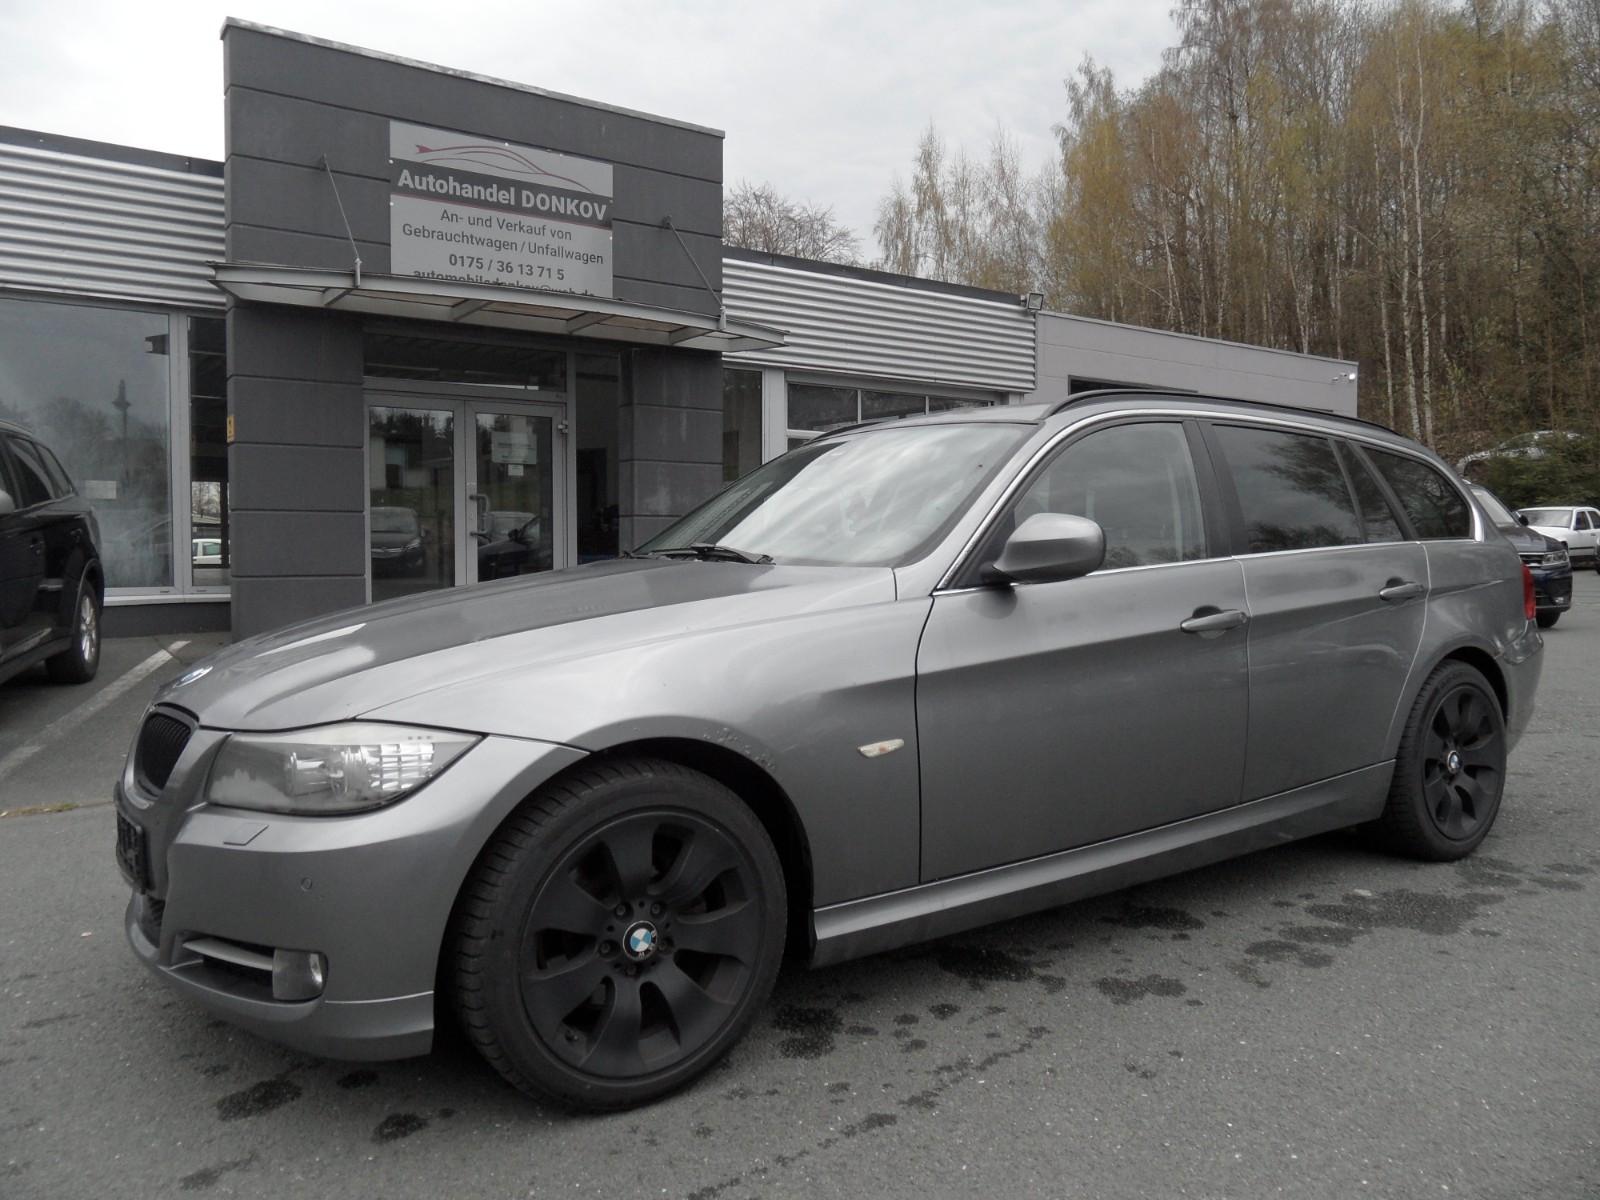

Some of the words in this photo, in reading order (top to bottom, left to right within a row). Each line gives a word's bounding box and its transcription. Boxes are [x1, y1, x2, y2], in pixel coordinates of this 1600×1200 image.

[397, 168, 515, 206] Autohandel
[521, 189, 607, 221] DONKOV
[440, 209, 464, 223] An-
[467, 215, 492, 228] und
[496, 217, 547, 237] Verkauf
[550, 228, 572, 240] von
[402, 223, 518, 252] Gebrauchtwagen
[528, 242, 604, 265] Unfallwagen
[448, 253, 484, 270] 0175
[496, 260, 514, 274] 36
[517, 263, 534, 276] 13
[536, 265, 552, 279] 71
[557, 268, 565, 281] 5
